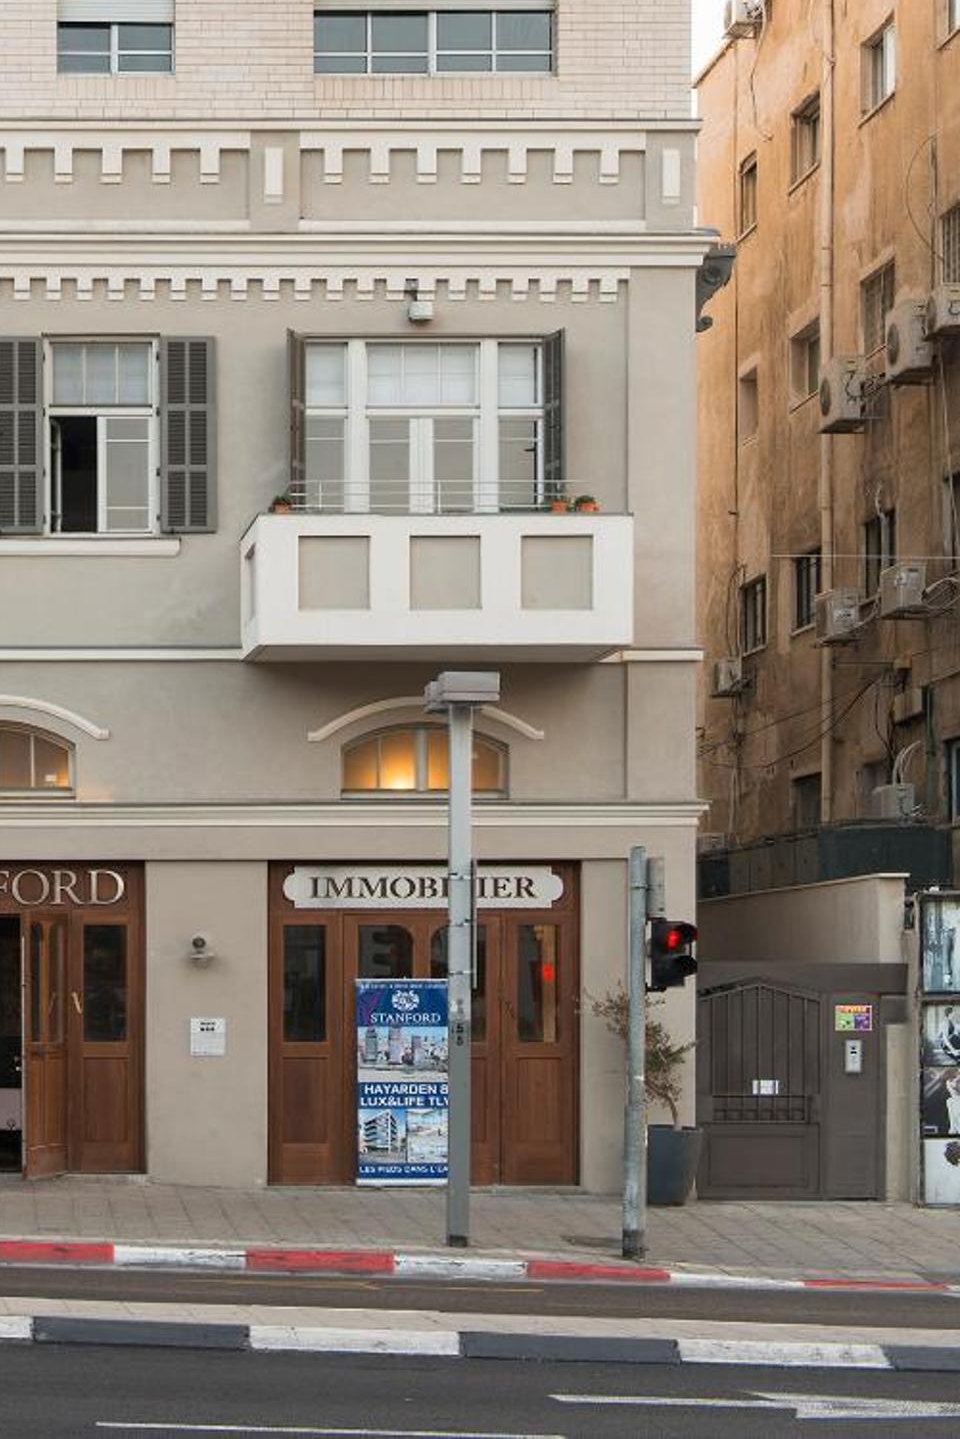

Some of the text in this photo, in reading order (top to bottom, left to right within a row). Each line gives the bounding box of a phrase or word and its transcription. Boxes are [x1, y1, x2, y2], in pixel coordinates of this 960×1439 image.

[309, 876, 539, 899] IMMOBIIER
[370, 1012, 441, 1024] STANFORD
[364, 1083, 437, 1095] HAYARDEN
[361, 1096, 426, 1106] LUX&LIFE
